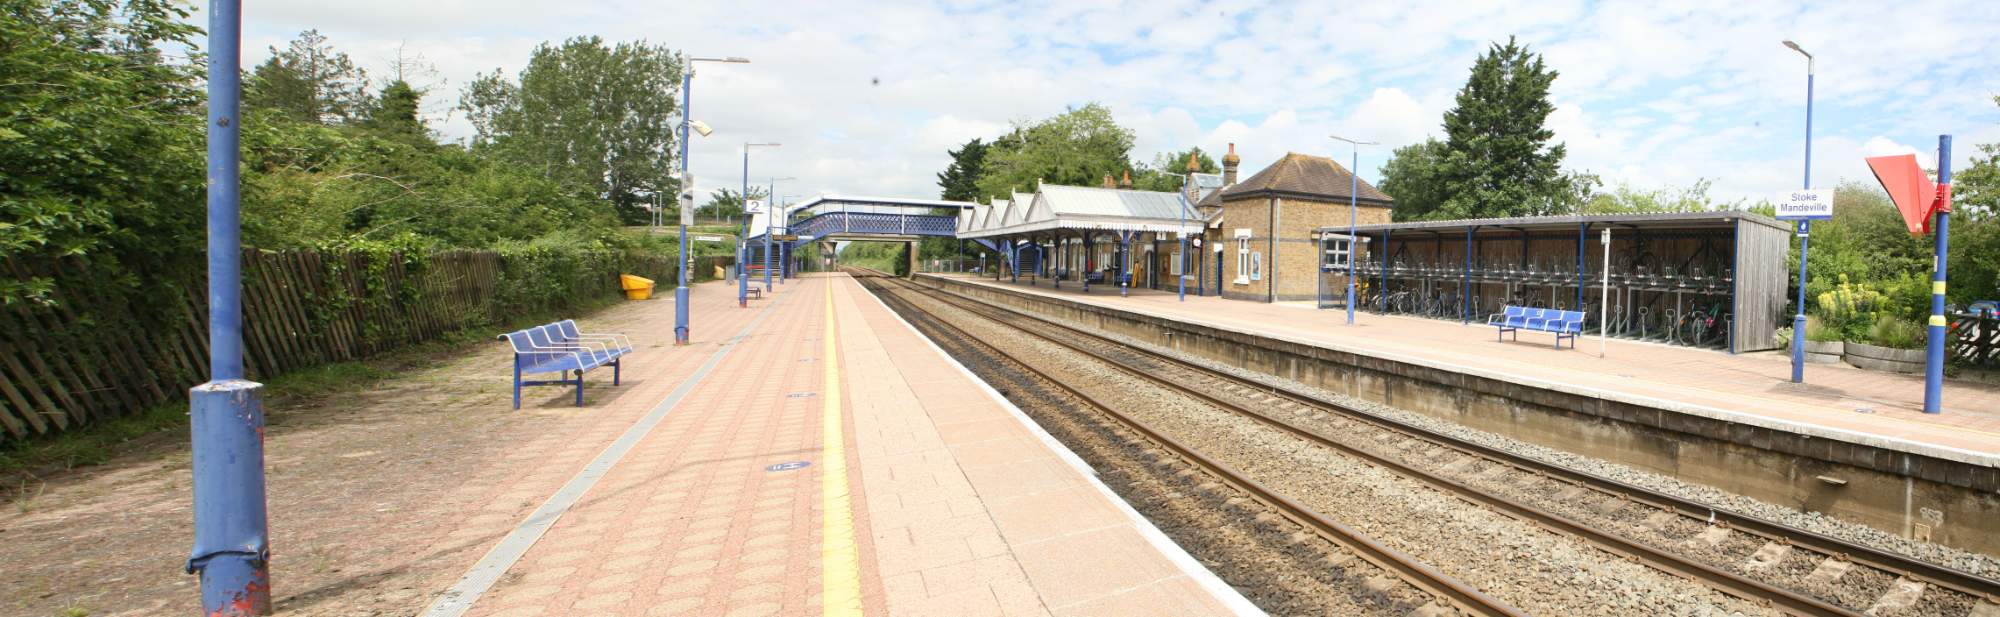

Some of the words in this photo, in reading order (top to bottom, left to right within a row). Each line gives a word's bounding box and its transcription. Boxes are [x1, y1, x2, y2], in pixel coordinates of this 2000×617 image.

[1791, 192, 1818, 202] Stoke
[750, 201, 761, 212] 2
[1780, 203, 1828, 212] Mandeville
